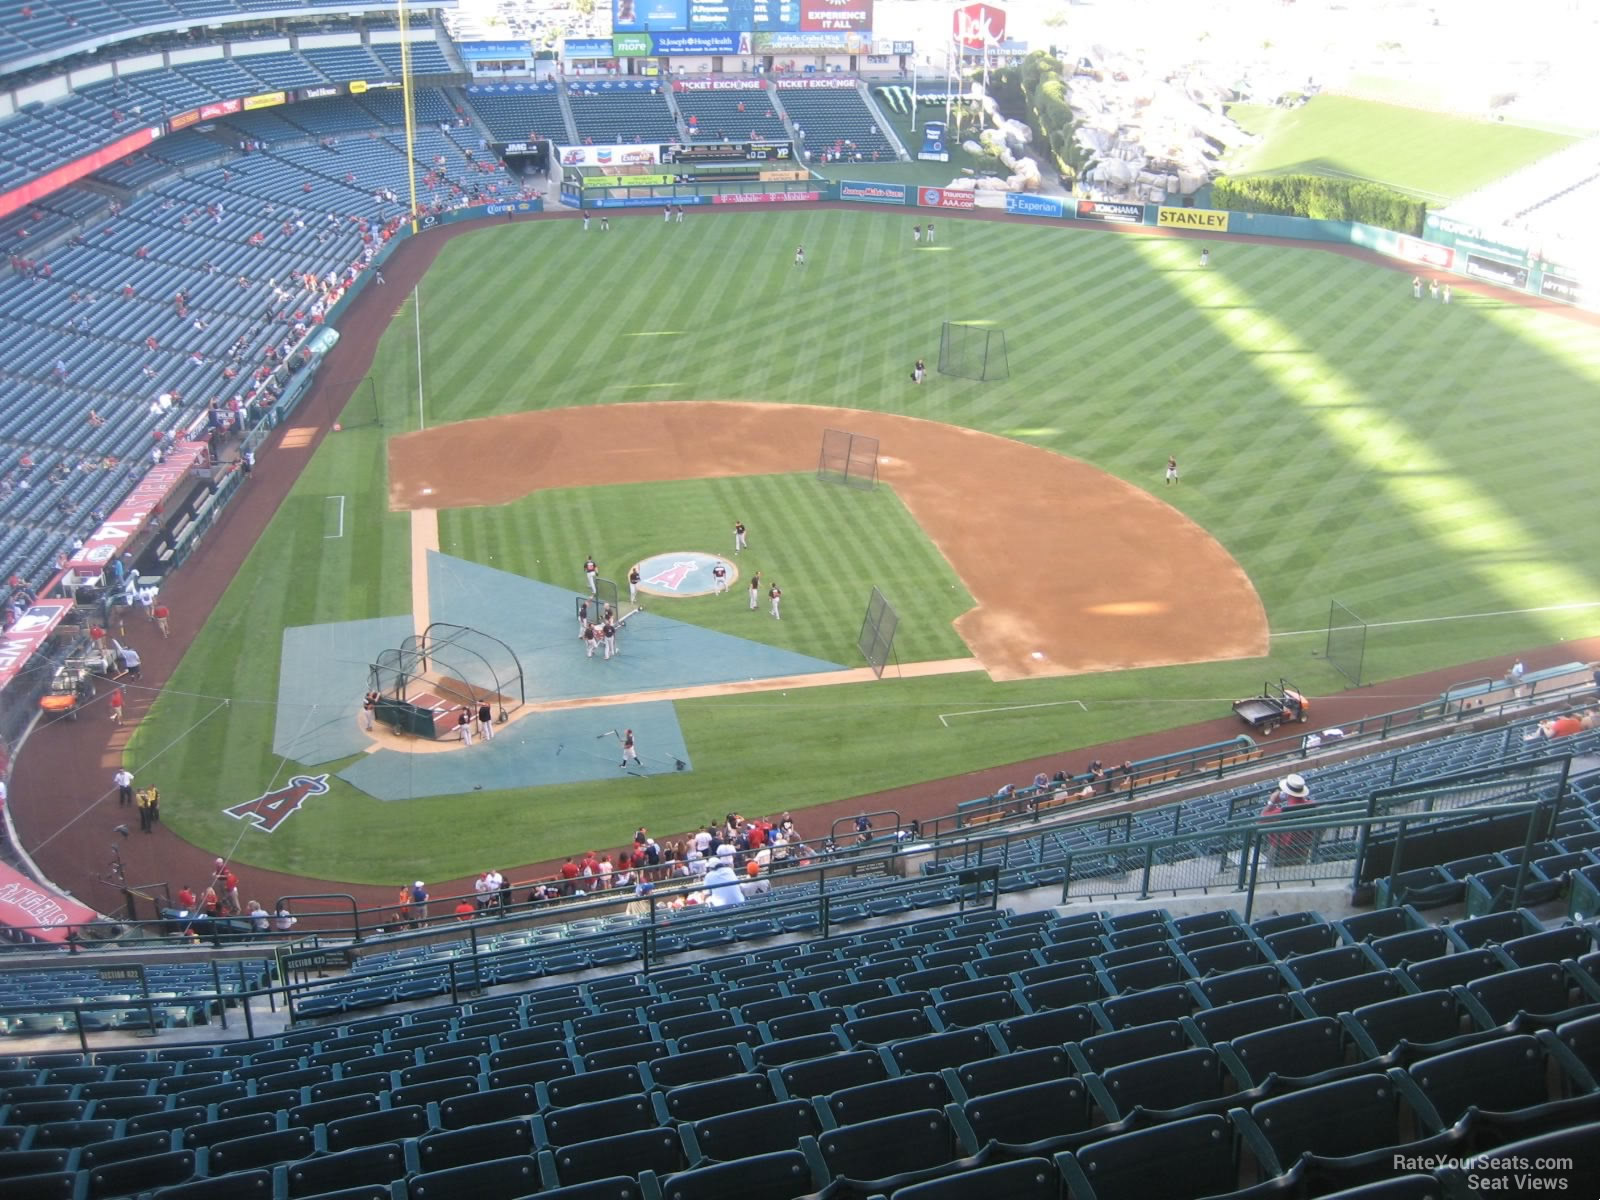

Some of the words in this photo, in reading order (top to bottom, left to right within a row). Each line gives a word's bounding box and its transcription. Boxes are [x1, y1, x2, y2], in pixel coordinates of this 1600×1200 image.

[808, 11, 866, 20] EXPERIENCE
[822, 20, 832, 28] IT
[834, 20, 851, 28] ALL
[618, 43, 646, 51] more
[777, 80, 807, 88] TICKET
[1018, 201, 1057, 212] Experian
[1094, 203, 1139, 215] YOKOHAMA
[1159, 210, 1226, 227] STANLEY
[0, 882, 69, 932] ANGELS
[288, 957, 313, 969] SECTION
